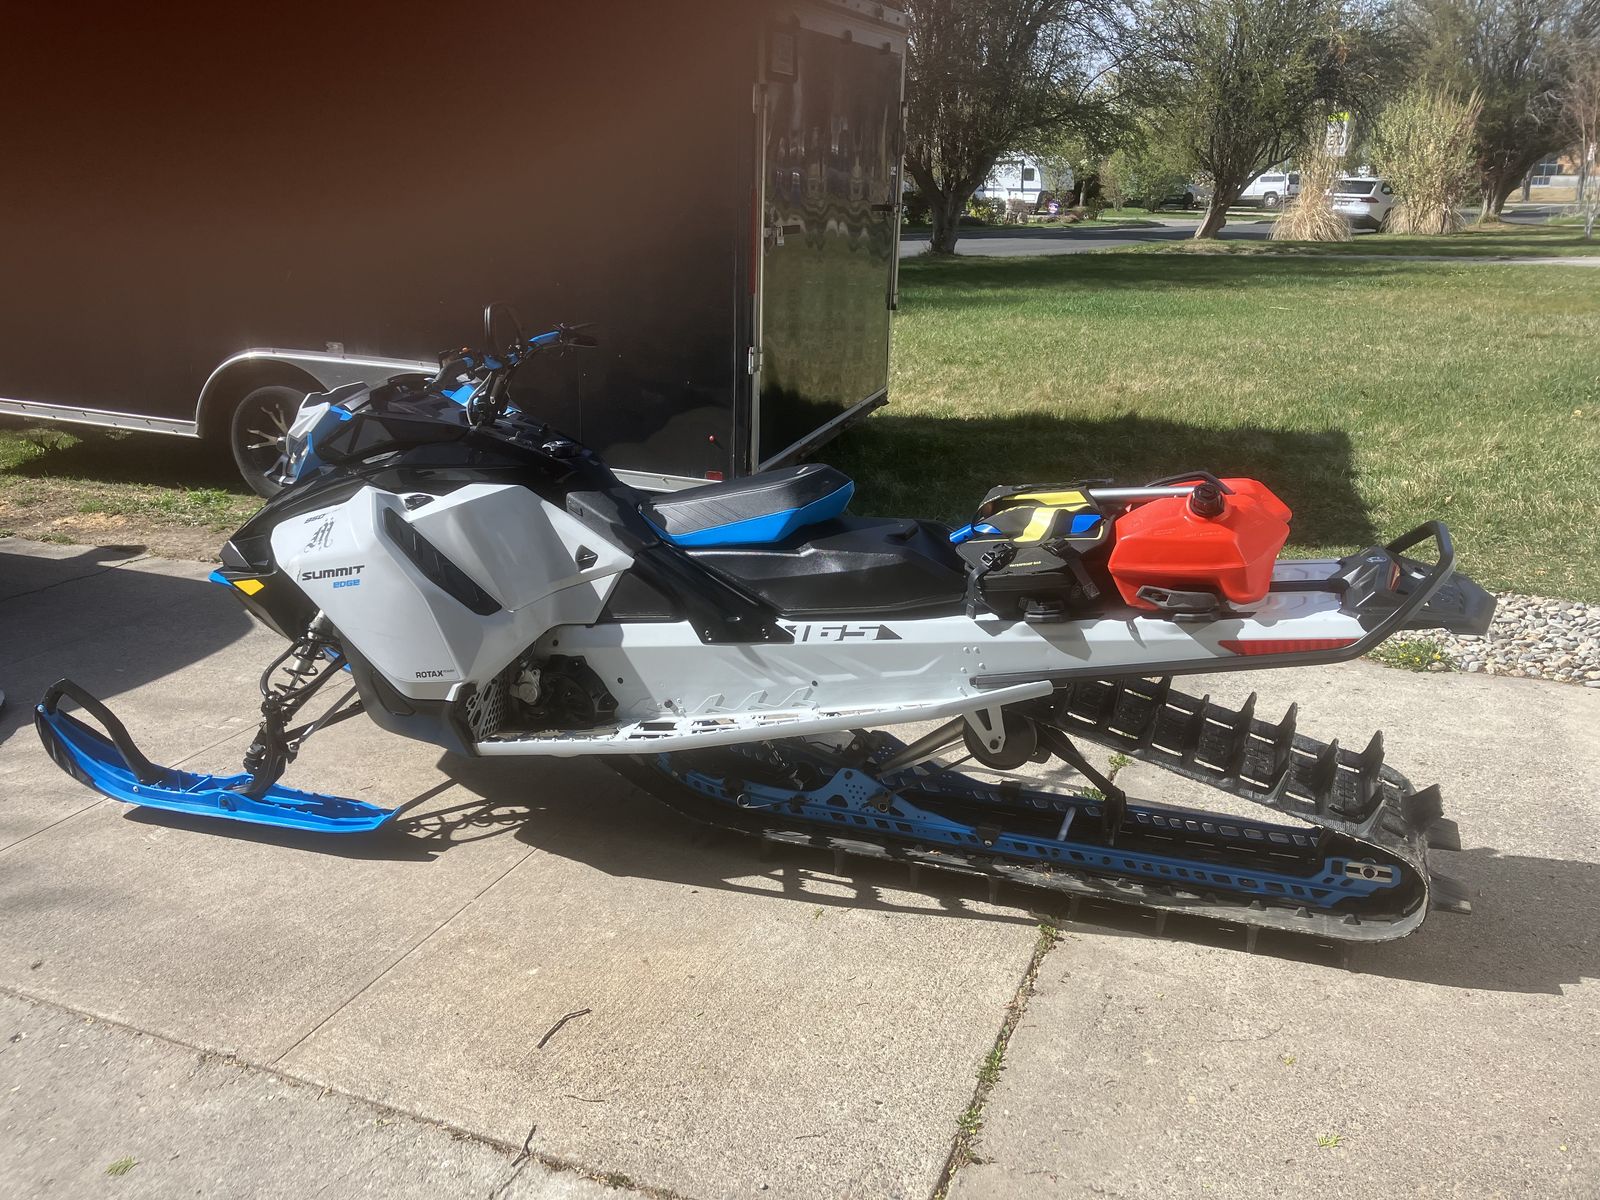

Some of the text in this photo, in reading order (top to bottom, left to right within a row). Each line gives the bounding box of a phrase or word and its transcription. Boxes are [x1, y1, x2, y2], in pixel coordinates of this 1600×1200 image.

[302, 565, 365, 581] SUMMIT
[333, 579, 360, 588] EDGE
[792, 623, 881, 641] 165
[415, 670, 444, 679] ROTAX
